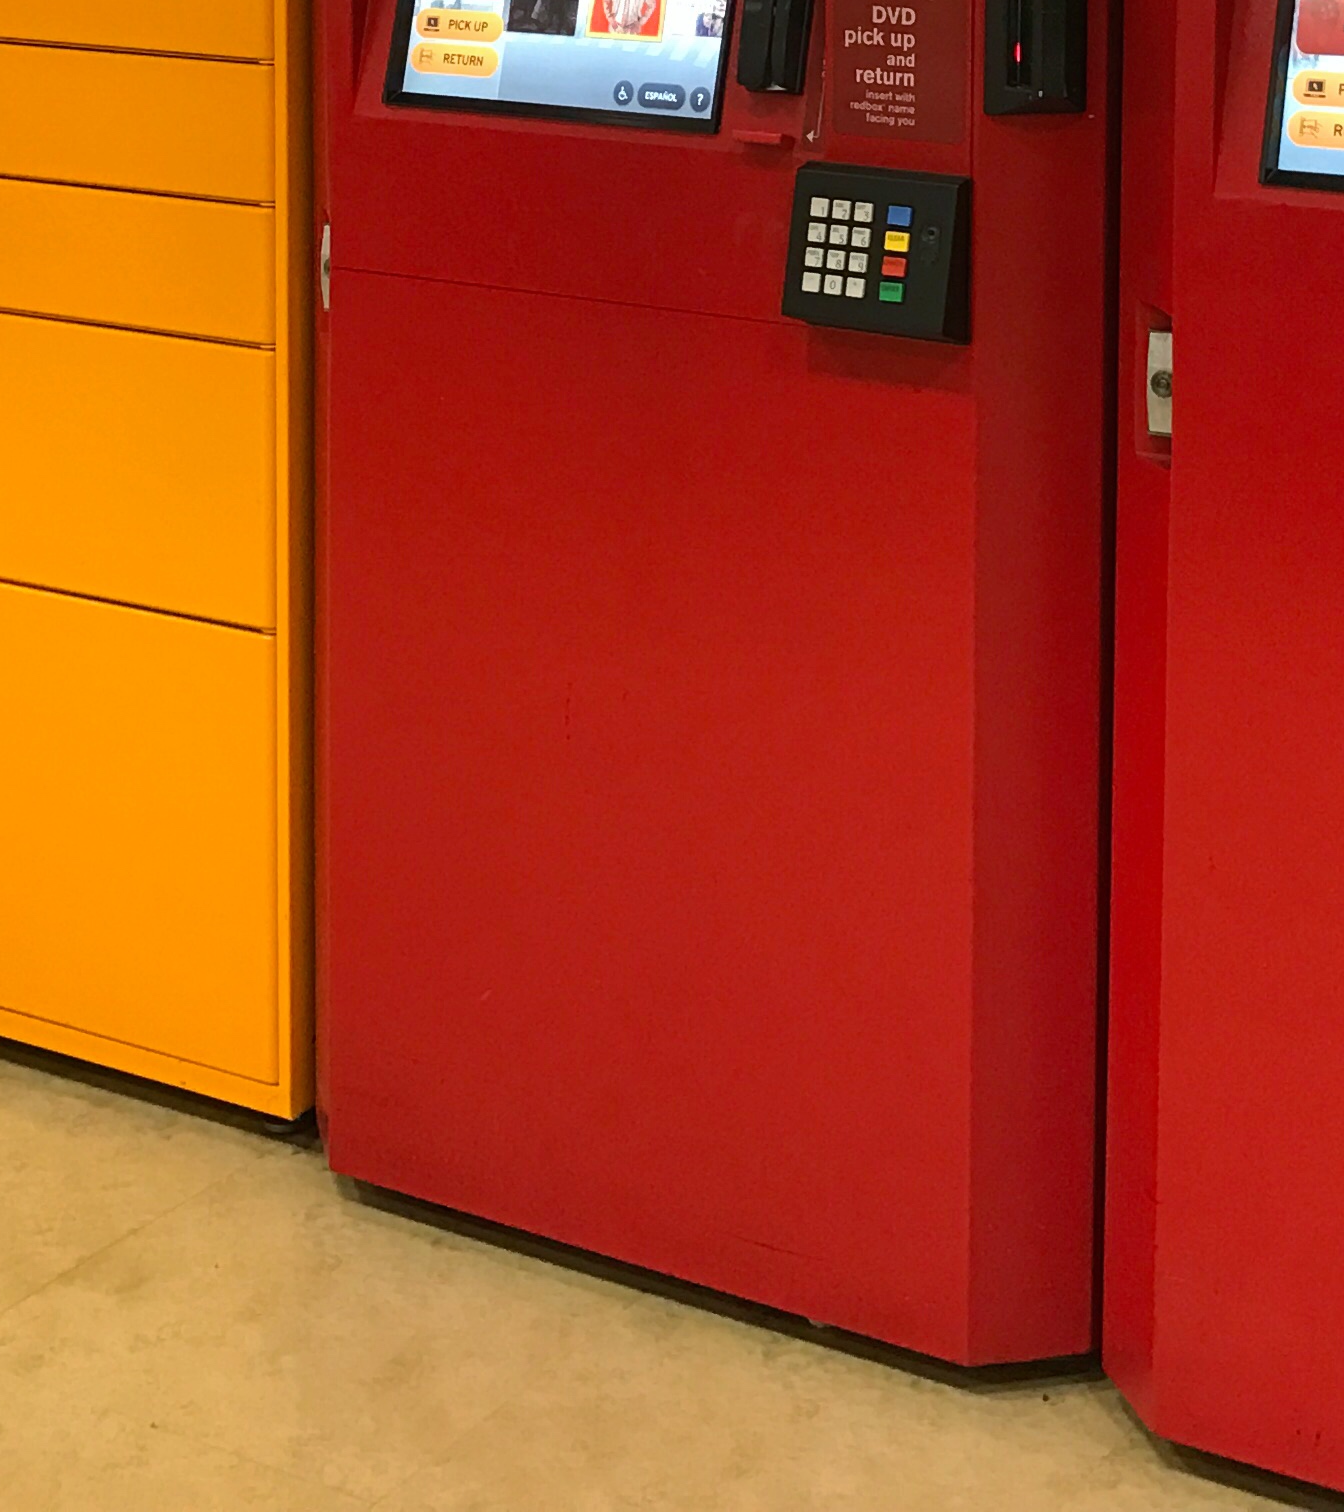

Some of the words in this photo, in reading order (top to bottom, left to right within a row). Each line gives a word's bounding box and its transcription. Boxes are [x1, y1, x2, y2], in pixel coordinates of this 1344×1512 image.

[872, 5, 916, 25] DVD
[448, 18, 472, 31] PICK
[475, 20, 489, 32] UP
[844, 26, 883, 47] pick
[891, 32, 915, 50] up
[442, 53, 484, 68] RETURN
[886, 52, 915, 67] and
[856, 68, 915, 87] return
